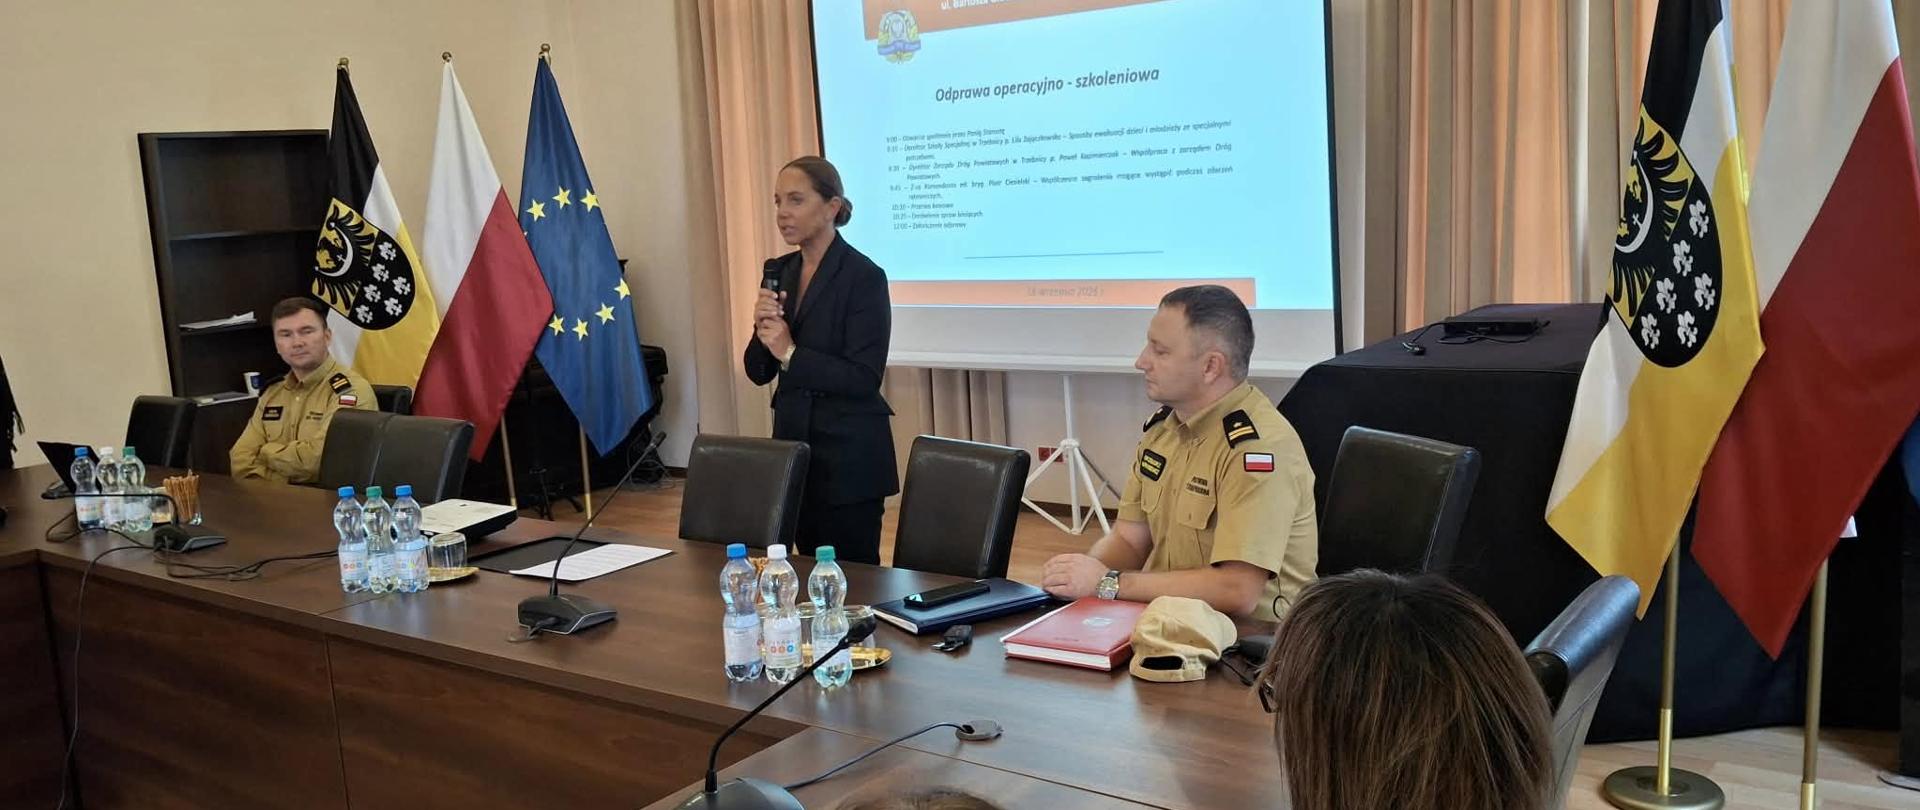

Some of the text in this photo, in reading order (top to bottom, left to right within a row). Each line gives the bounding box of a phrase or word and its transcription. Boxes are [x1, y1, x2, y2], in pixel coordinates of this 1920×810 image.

[936, 86, 990, 102] Odprawa
[994, 76, 1063, 98] operacyjno
[1076, 68, 1160, 88] szkoleniowa
[1216, 143, 1232, 152] Dróg
[1176, 168, 1202, 176] podczas
